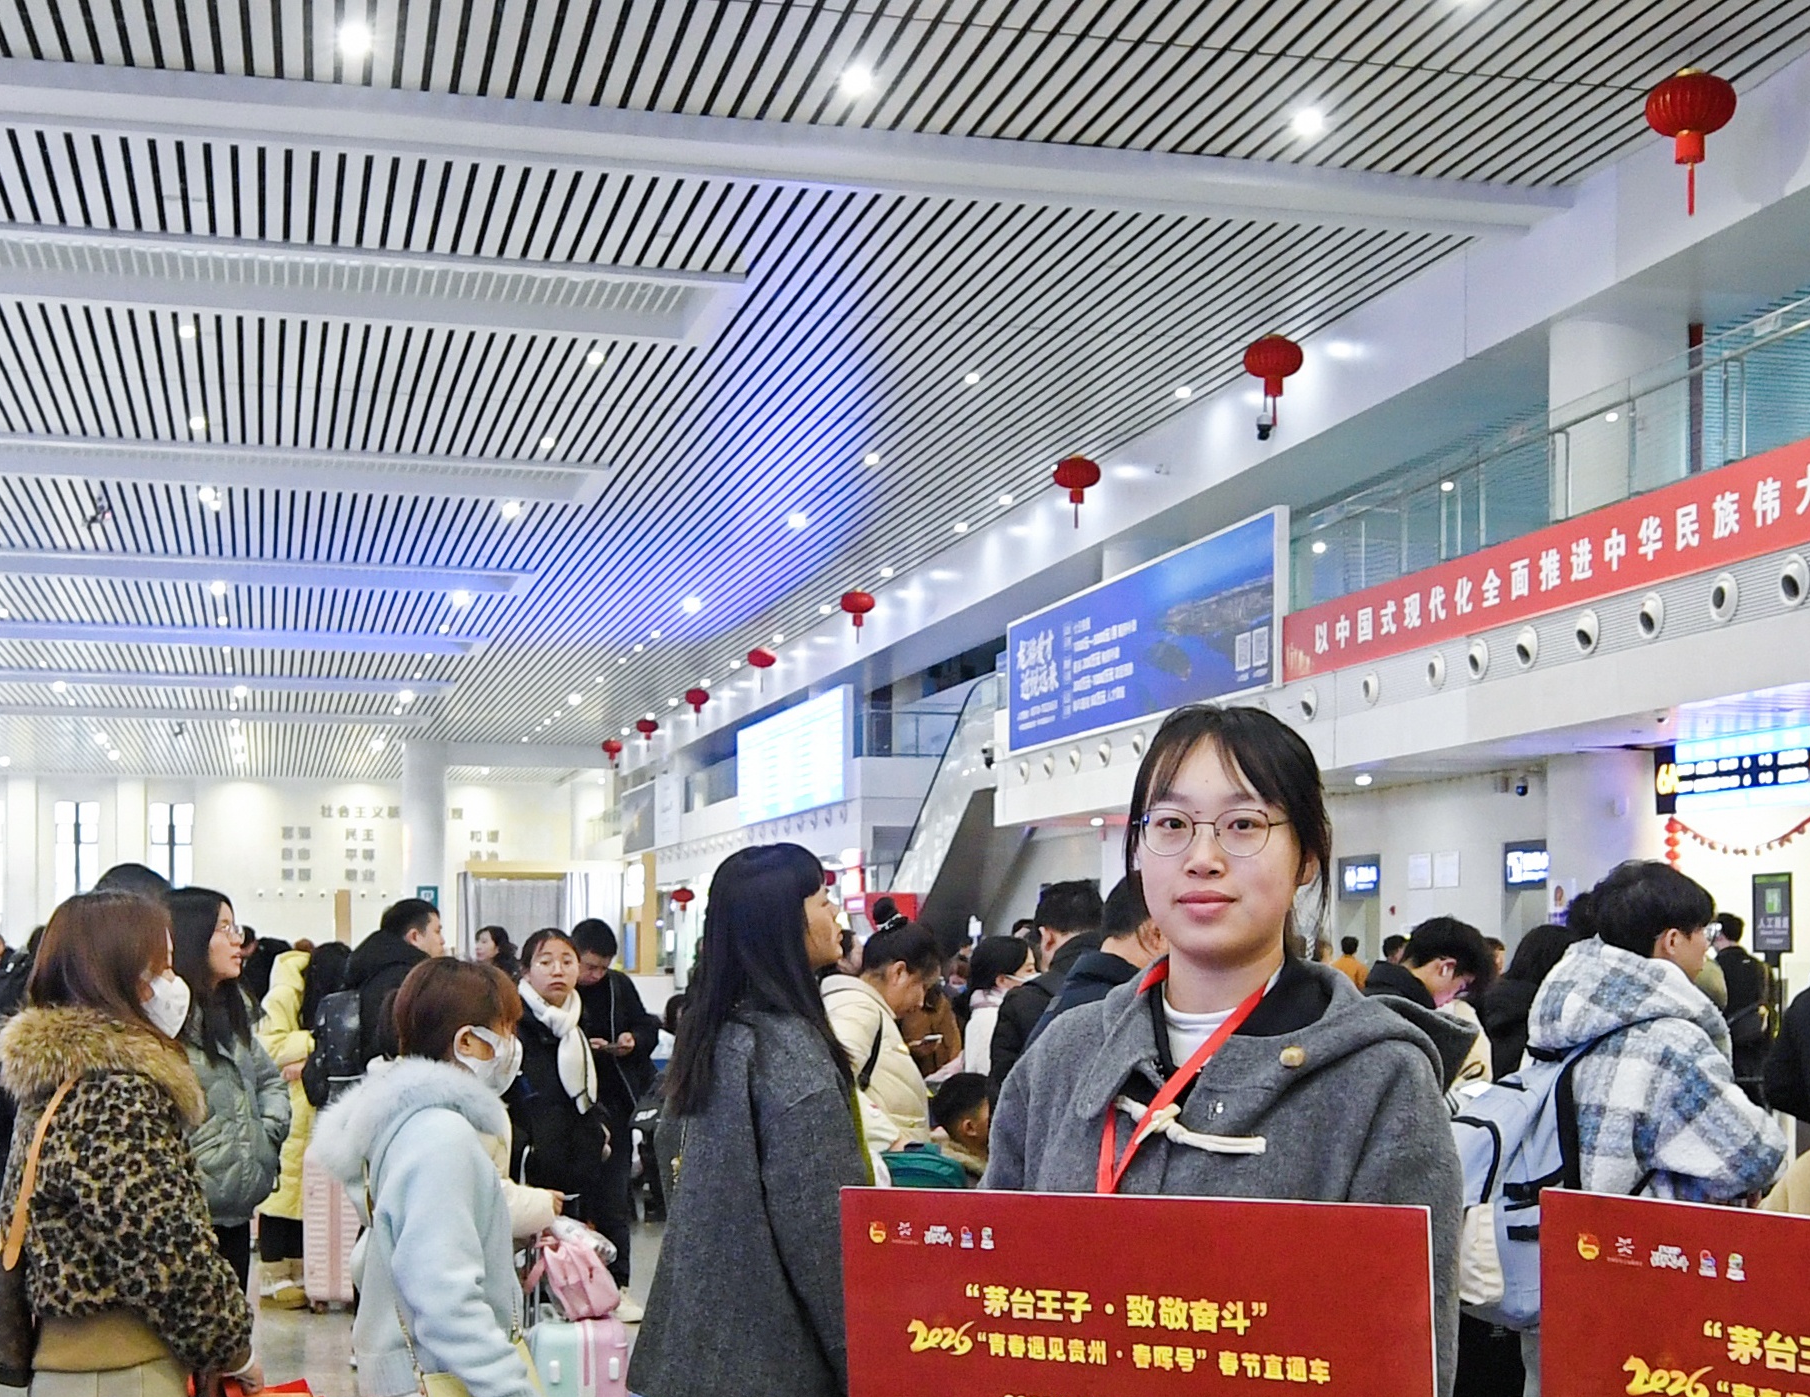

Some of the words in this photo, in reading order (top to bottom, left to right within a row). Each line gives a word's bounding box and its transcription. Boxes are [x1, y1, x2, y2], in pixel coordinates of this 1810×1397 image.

[907, 1319, 975, 1356] 2026
[1218, 1349, 1331, 1384] 春节直通车
